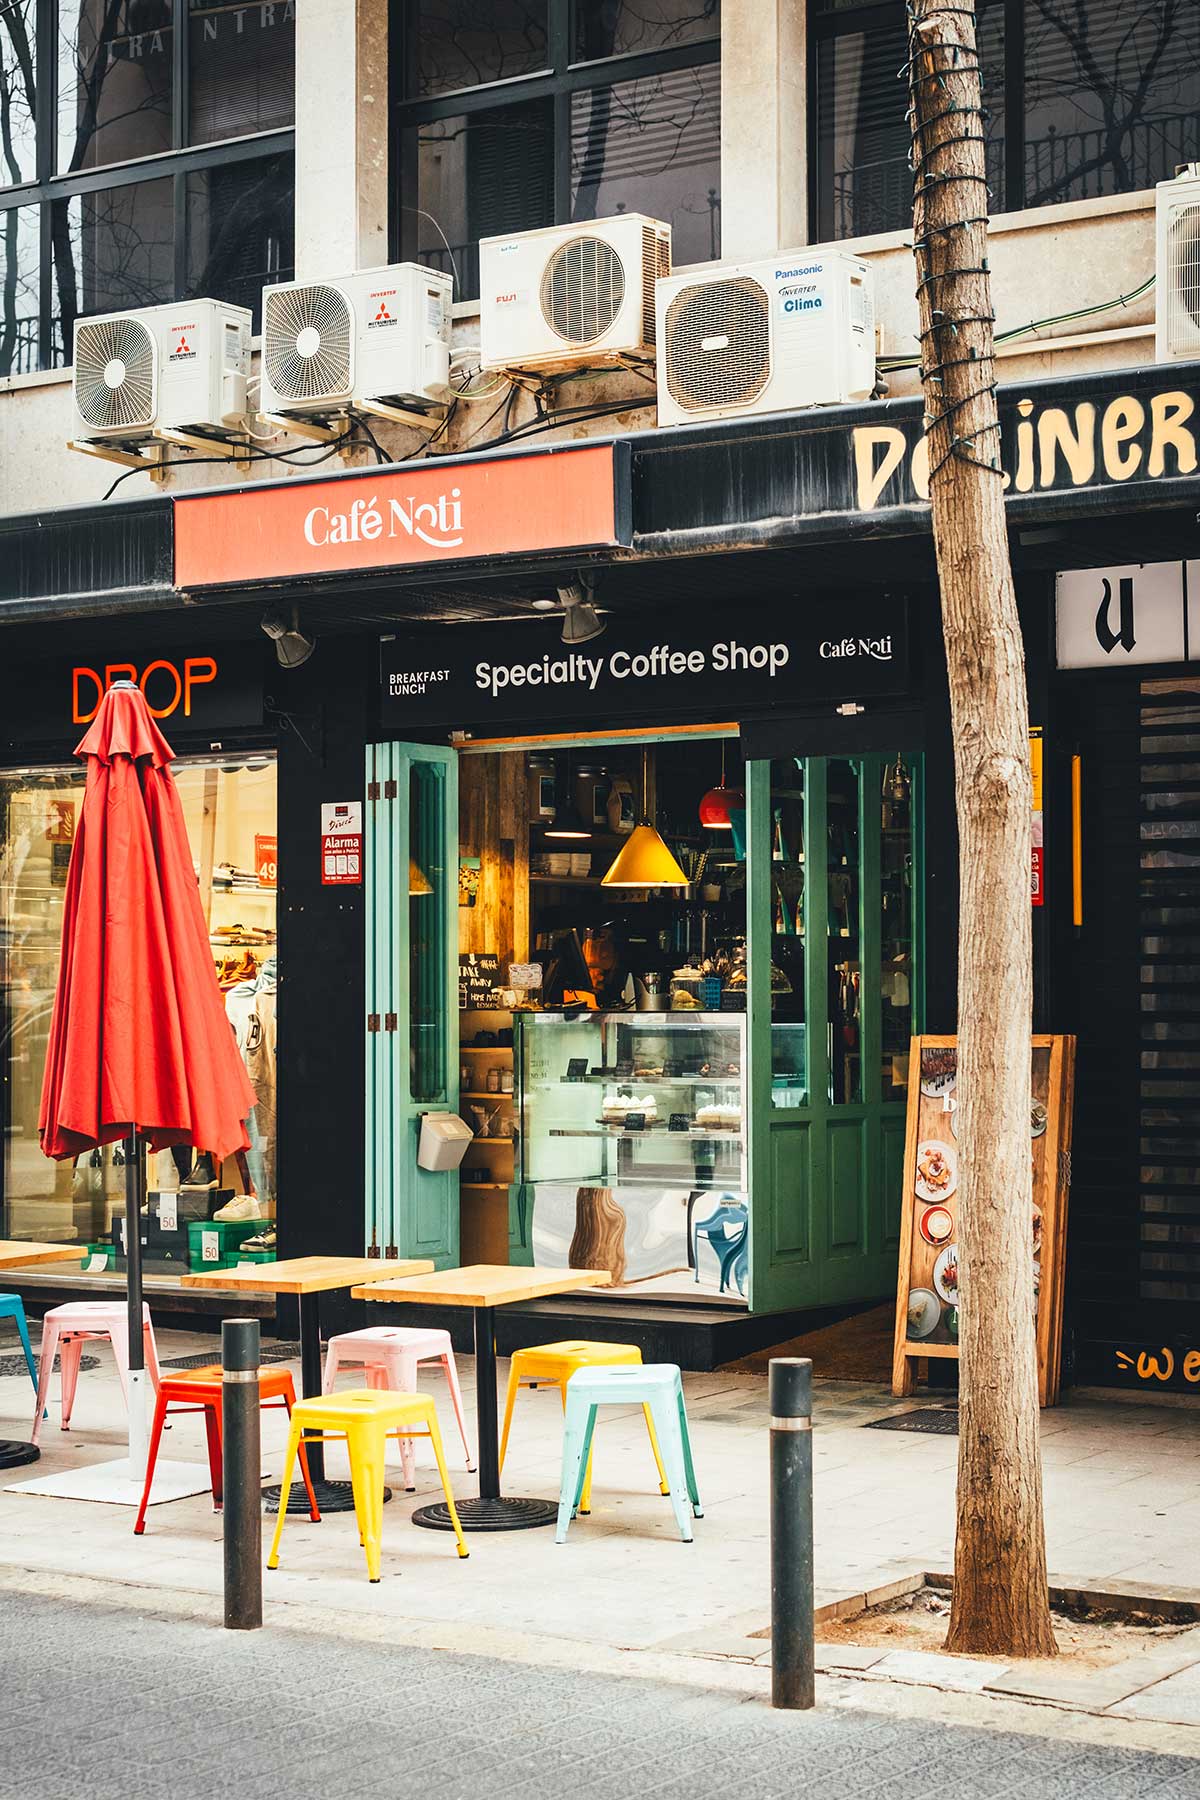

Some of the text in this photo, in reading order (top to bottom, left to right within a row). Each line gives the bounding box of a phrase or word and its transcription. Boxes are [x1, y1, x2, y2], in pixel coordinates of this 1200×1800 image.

[775, 264, 823, 279] Panasonic
[782, 285, 816, 296] INVERTER
[784, 298, 822, 312] Clima
[304, 488, 464, 548] Café Noti
[819, 636, 892, 660] Café Noti
[475, 640, 789, 697] Specialty Coffee Shop
[389, 670, 450, 685] BREAKFAST
[389, 683, 426, 695] LUNCH
[324, 837, 359, 848] Alarma
[260, 862, 277, 880] 49
[458, 966, 479, 977] TAKE
[470, 978, 492, 987] AWAY
[162, 1216, 175, 1228] 50
[205, 1247, 217, 1259] 50
